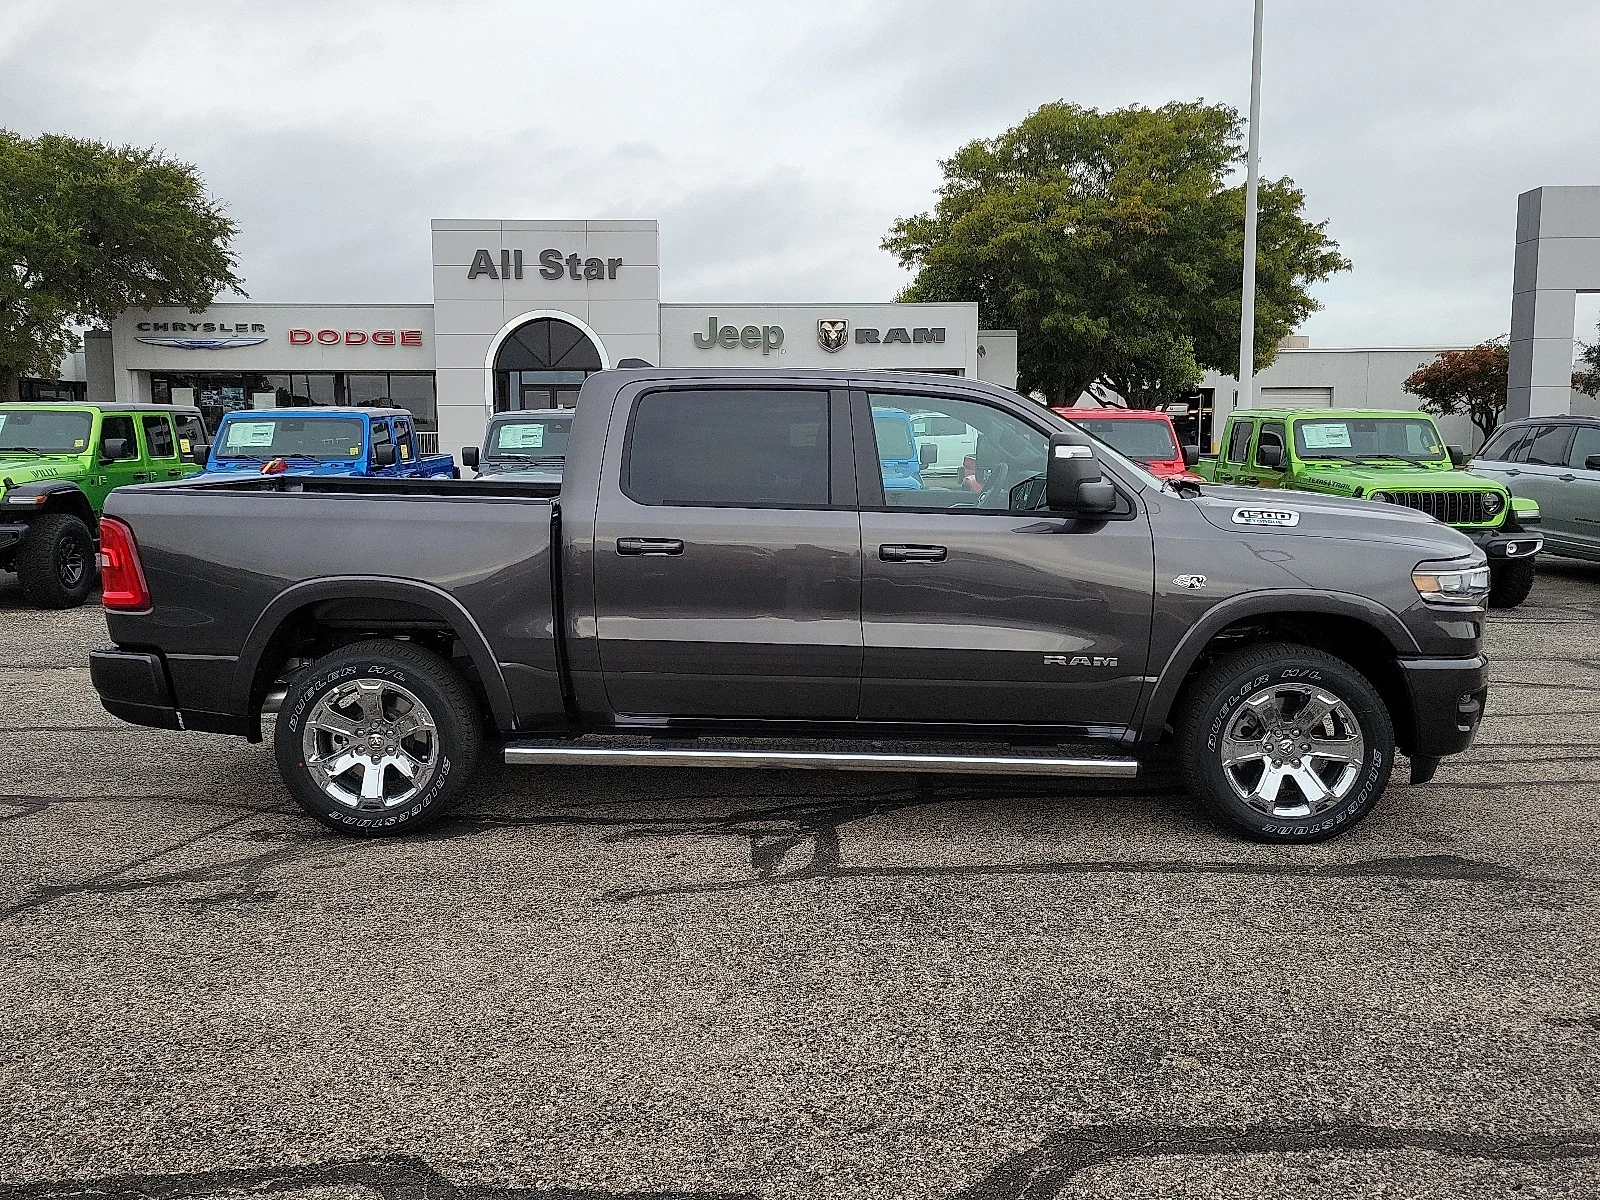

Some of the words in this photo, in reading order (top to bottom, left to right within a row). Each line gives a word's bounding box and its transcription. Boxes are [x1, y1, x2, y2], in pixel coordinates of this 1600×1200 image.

[467, 249, 523, 280] All
[538, 248, 623, 281] Star
[136, 322, 266, 333] CHRYSLER
[288, 328, 423, 346] DODGE
[693, 316, 785, 355] Jeep
[854, 327, 946, 344] RAM
[30, 467, 59, 478] WILLYS
[1239, 510, 1293, 520] 1500
[1043, 655, 1118, 667] RAM
[288, 665, 357, 733] DUELER
[367, 664, 406, 682] H/L
[1207, 673, 1270, 753] DUELER
[1280, 668, 1322, 681] H/L
[328, 755, 451, 828] BRIDGESTONE
[1262, 748, 1383, 836] BRIDGESTONE
